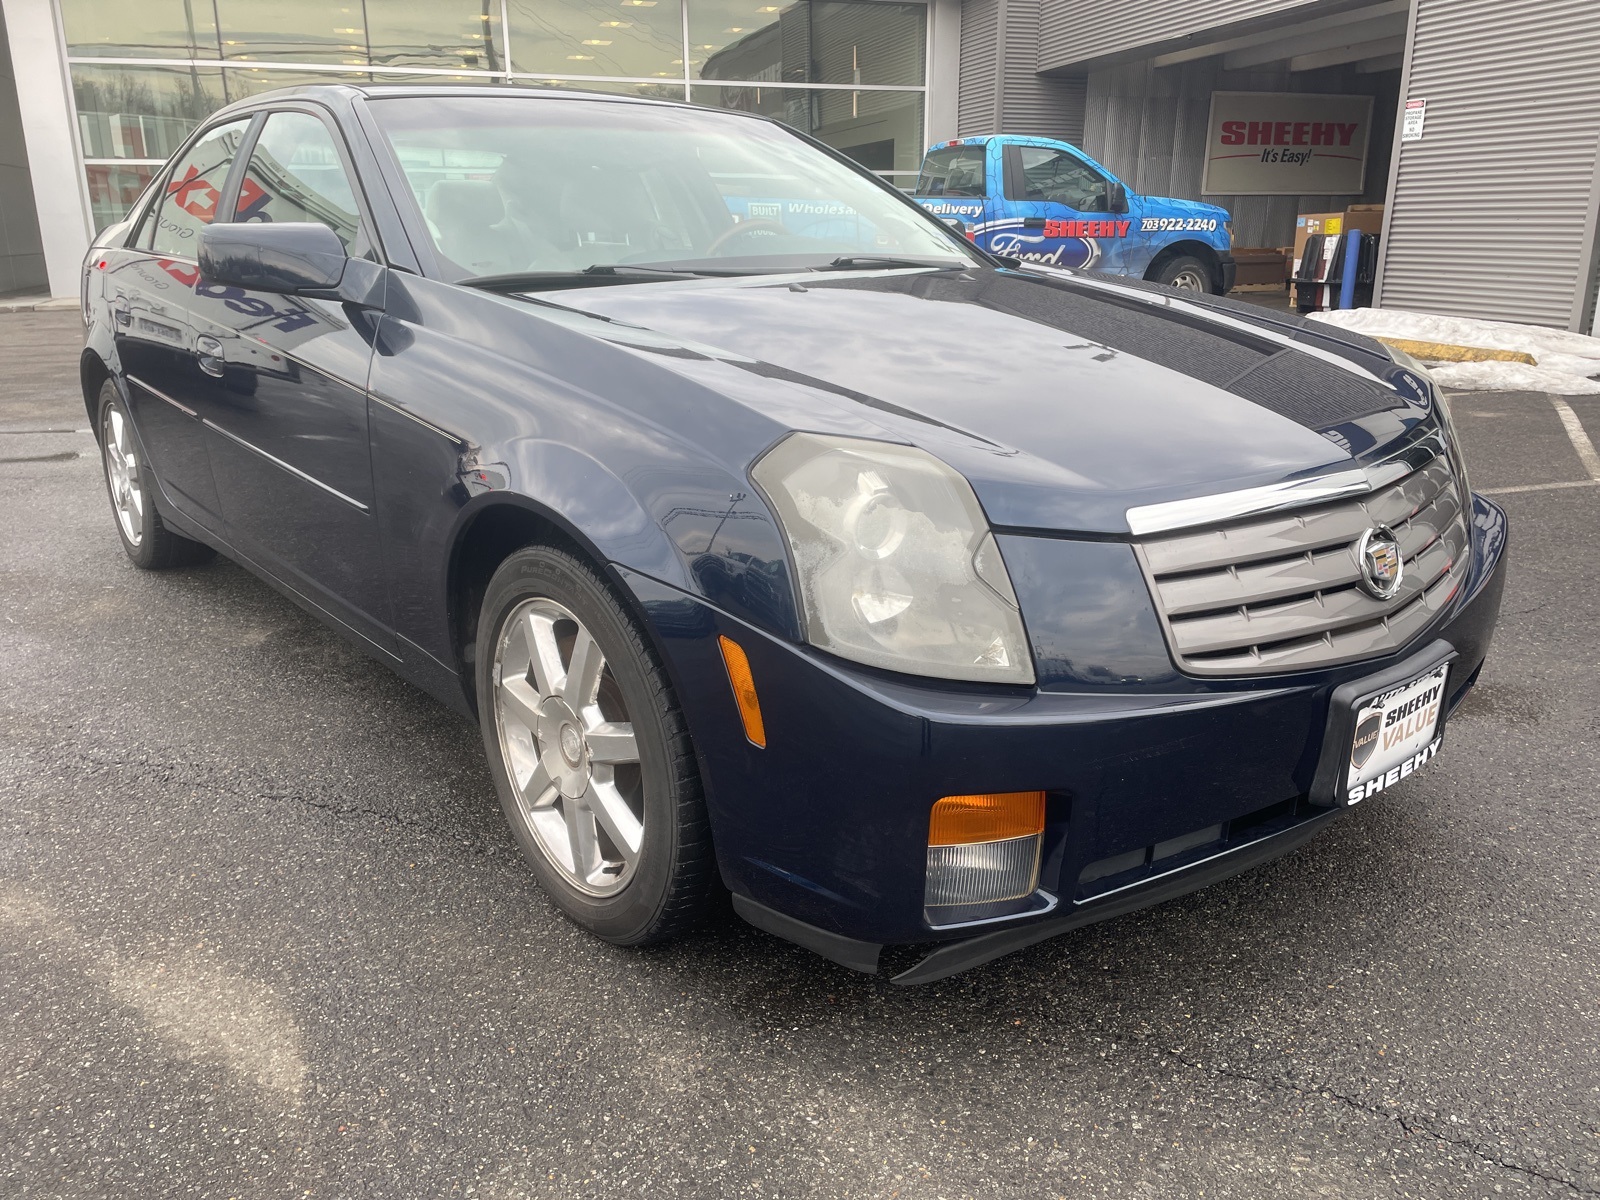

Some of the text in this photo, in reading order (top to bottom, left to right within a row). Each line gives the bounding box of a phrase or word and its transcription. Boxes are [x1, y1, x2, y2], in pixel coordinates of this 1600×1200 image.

[1220, 121, 1359, 146] SHEEHY
[1260, 148, 1312, 166] It's Easy!
[752, 206, 778, 216] BUILT
[922, 203, 983, 217] Delivery
[1042, 219, 1131, 238] SHEEHY
[1385, 683, 1442, 728] SHEEHY
[1382, 702, 1438, 751] VALUE
[1353, 730, 1379, 749] VALUE
[1347, 737, 1442, 806] SHEEHY
